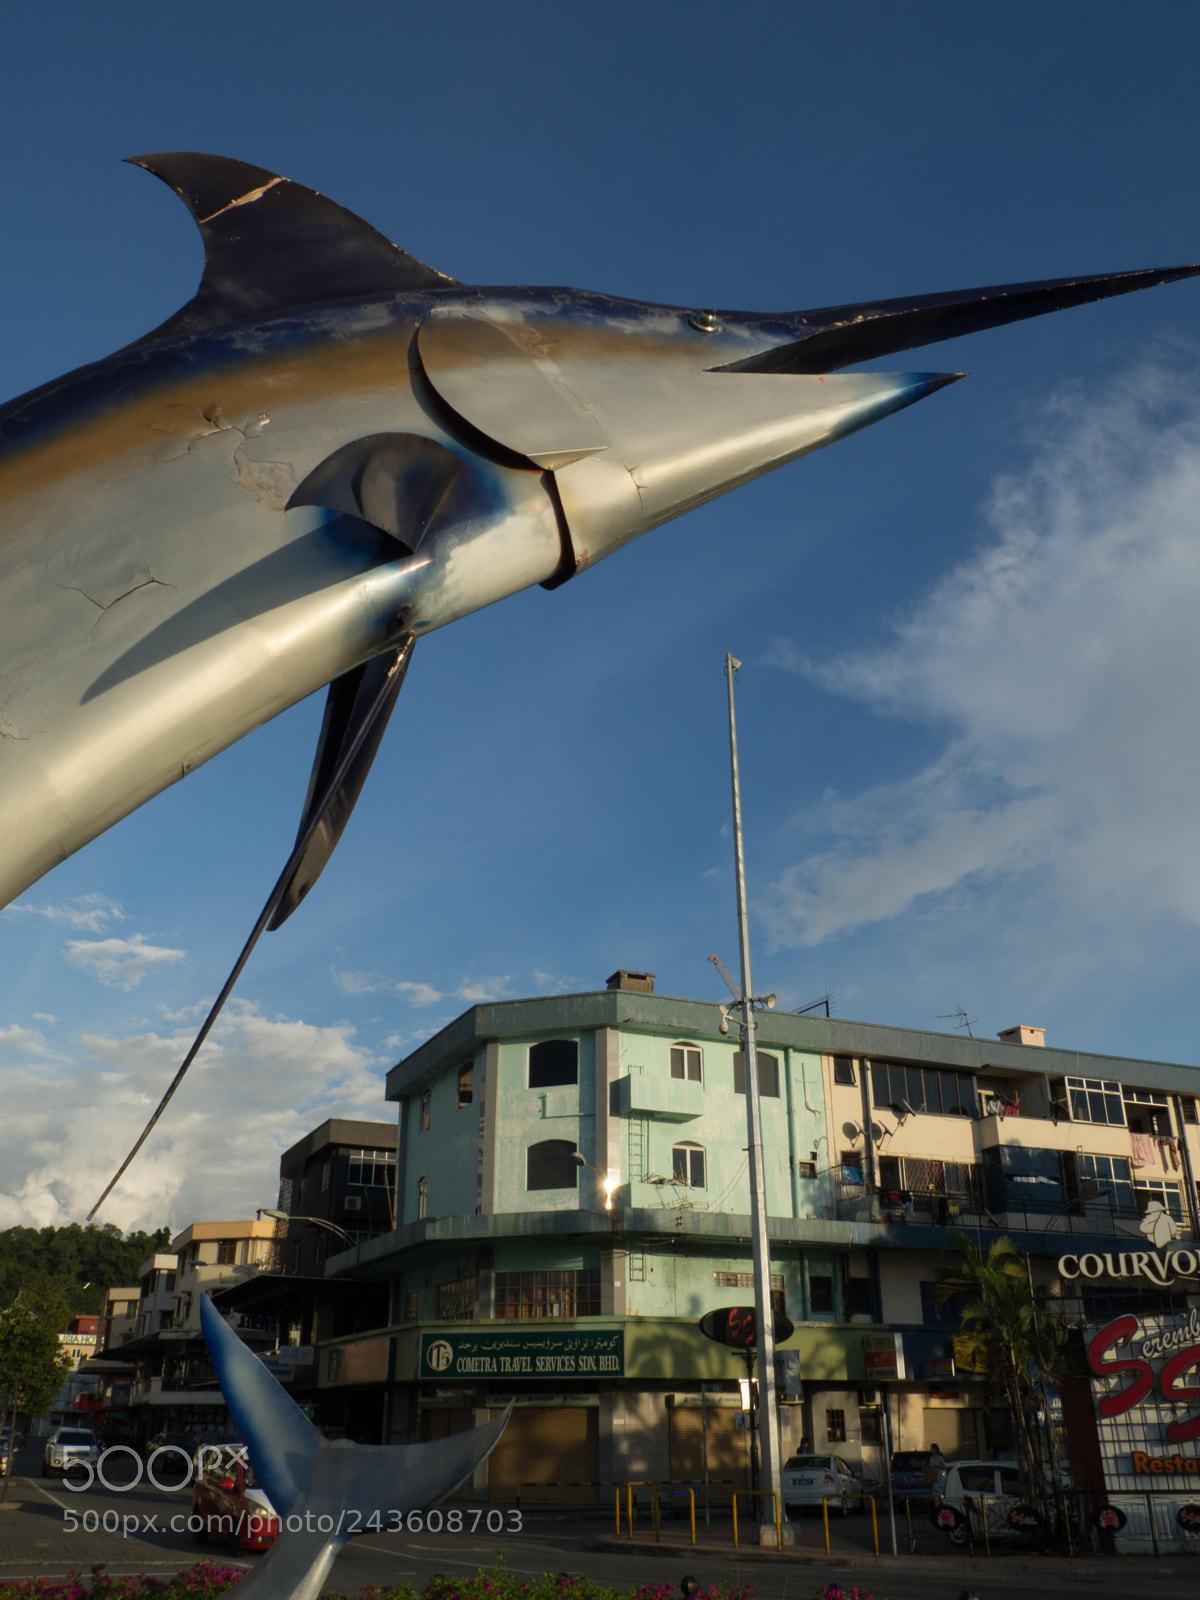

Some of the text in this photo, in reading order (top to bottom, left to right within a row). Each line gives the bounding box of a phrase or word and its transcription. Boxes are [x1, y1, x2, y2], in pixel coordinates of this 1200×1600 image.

[456, 1355, 620, 1373] COMETRA TRAVEL SERVICES SDN. BHD.
[1131, 1452, 1200, 1473] Resta
